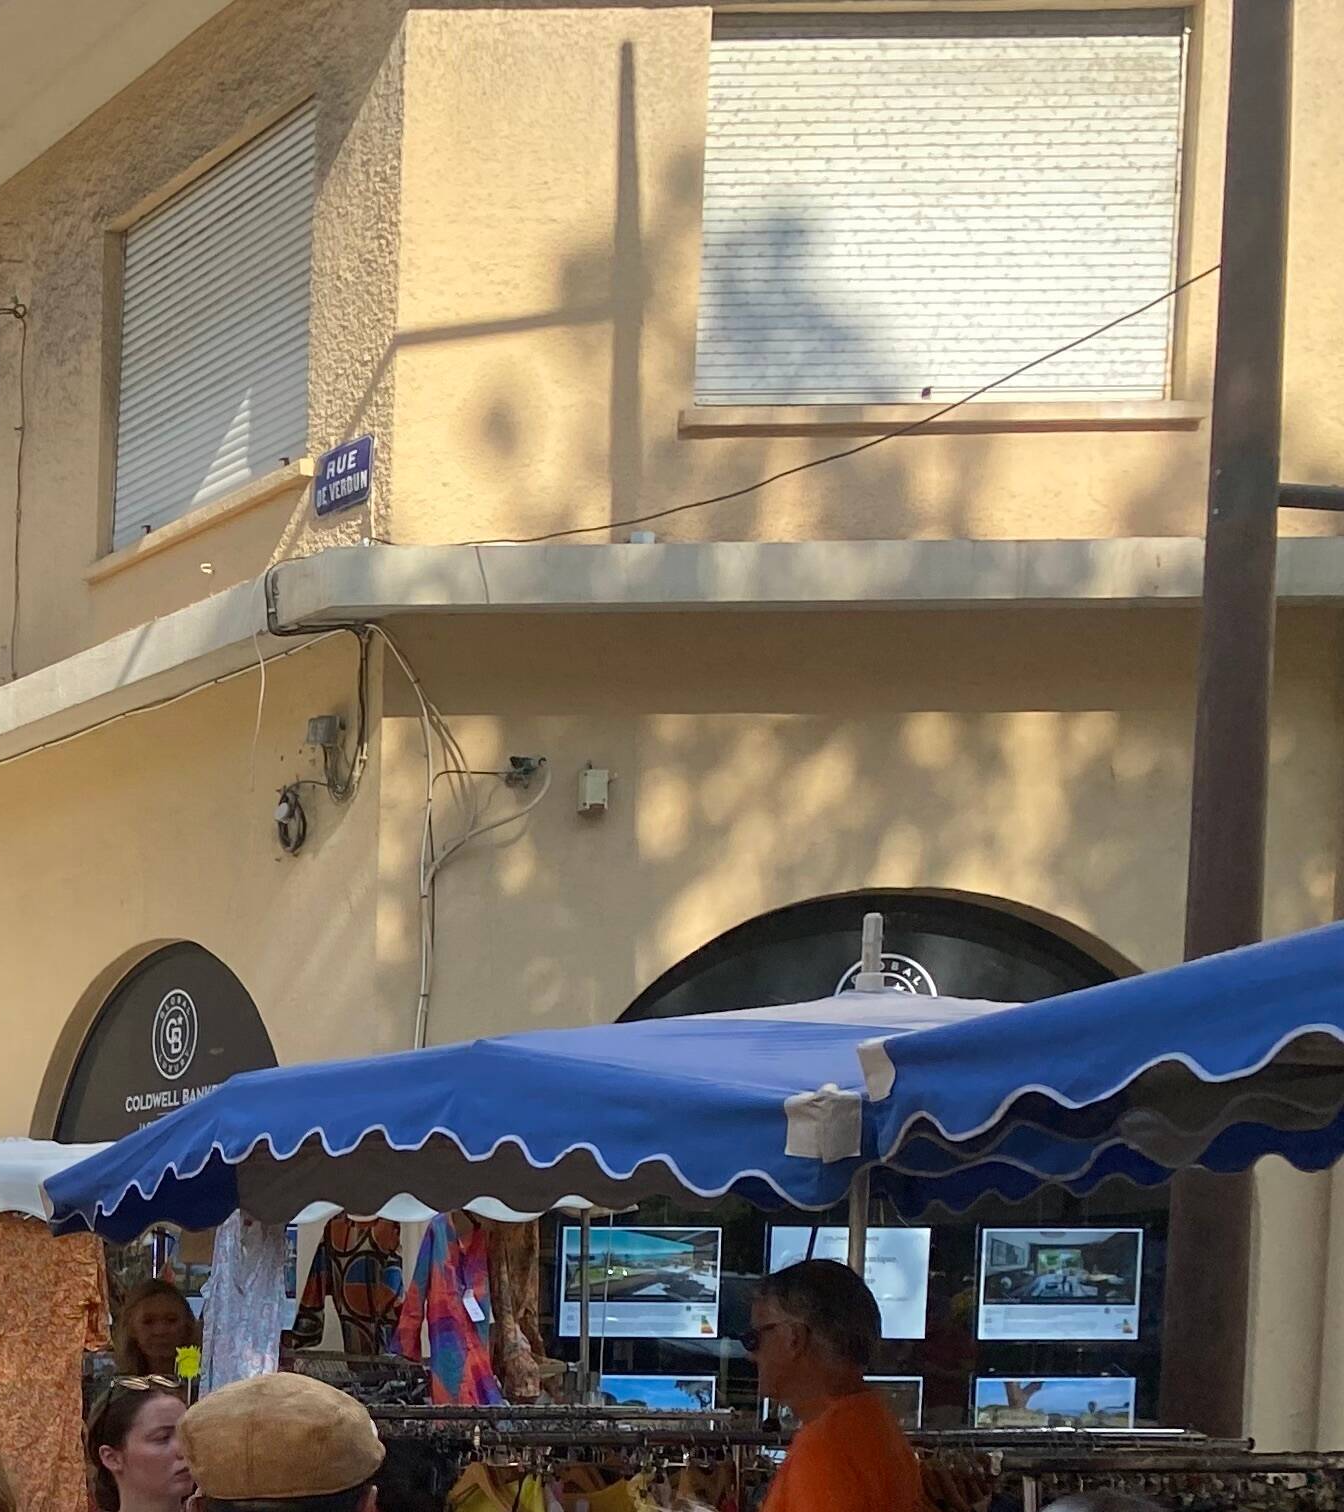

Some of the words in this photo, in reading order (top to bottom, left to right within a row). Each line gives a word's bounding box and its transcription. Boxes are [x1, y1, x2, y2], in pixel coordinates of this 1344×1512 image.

[326, 449, 358, 480] RUE
[316, 486, 328, 508] DE
[329, 470, 368, 501] VERDUN
[125, 1090, 179, 1112] COLDWELL
